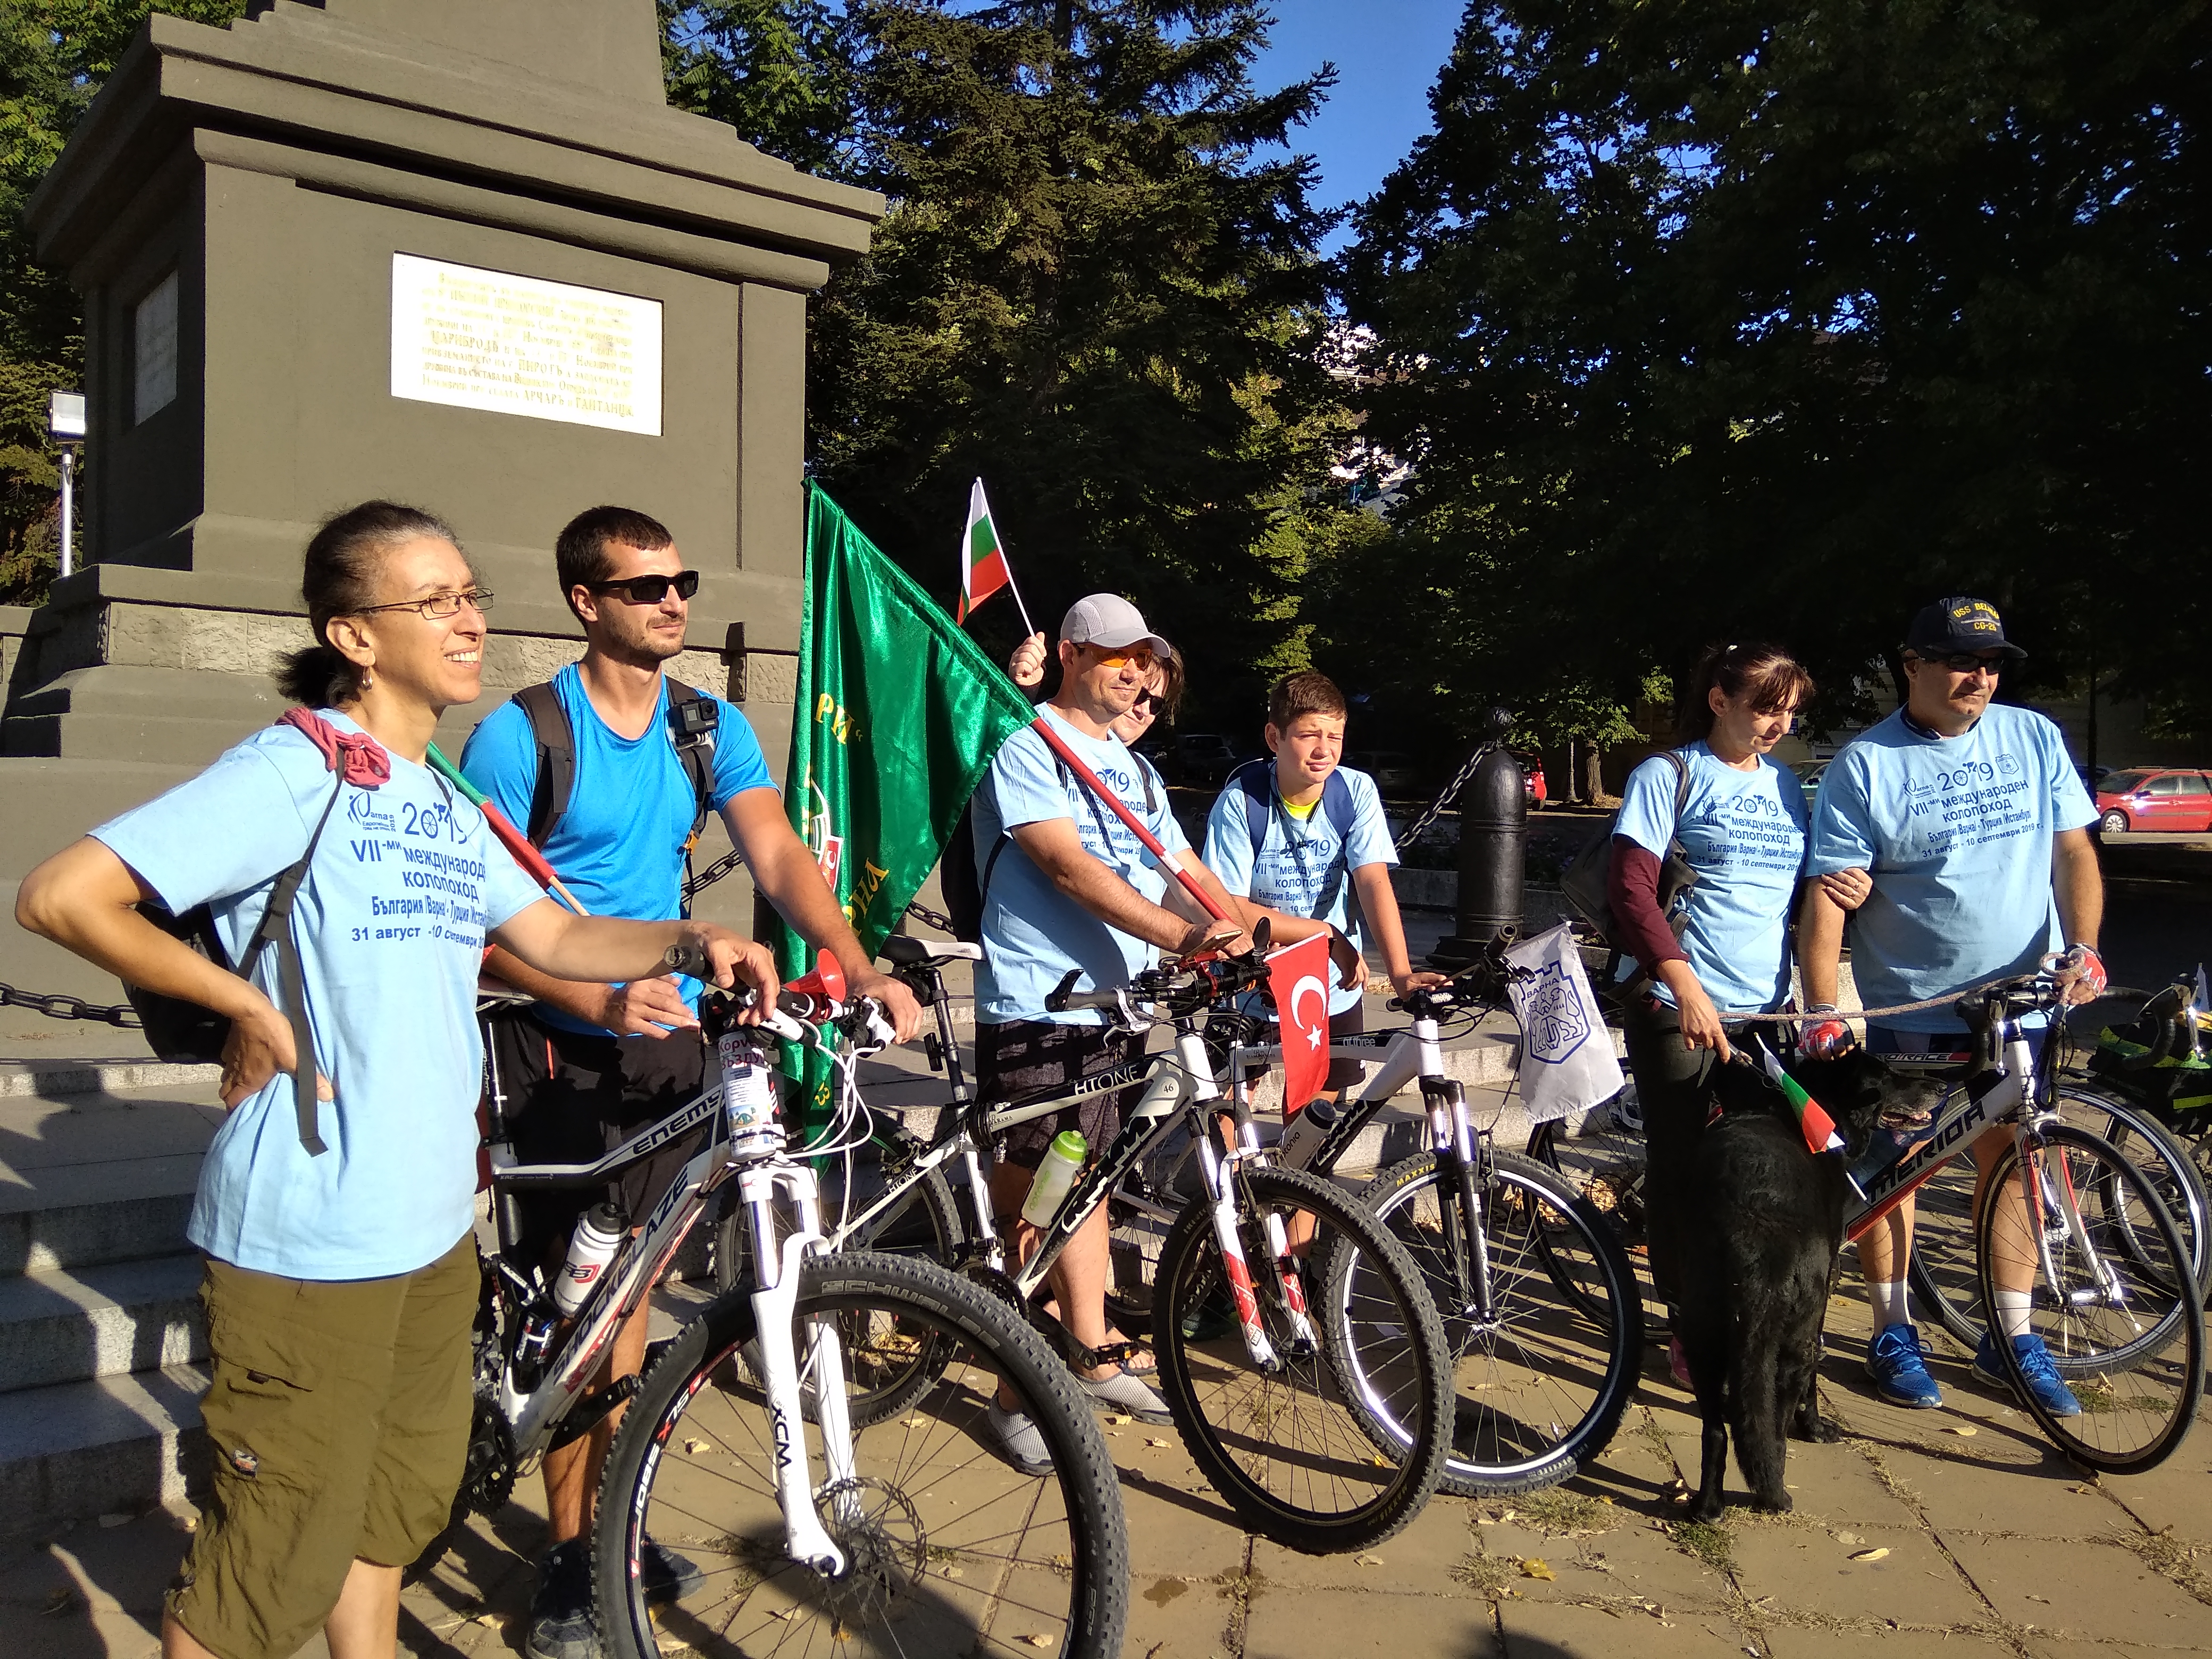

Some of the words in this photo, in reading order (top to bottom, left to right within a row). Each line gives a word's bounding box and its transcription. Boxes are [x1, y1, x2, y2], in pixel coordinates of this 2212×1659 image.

[1954, 606, 1972, 617] USS
[1732, 795, 1778, 816] 2019
[1941, 780, 2029, 808] международен
[1942, 799, 2013, 823] колопоход
[1729, 828, 1790, 846] колопоход
[1922, 849, 1932, 858] 31
[1935, 842, 1958, 856] август
[1977, 829, 2021, 844] септември
[2021, 825, 2035, 834] 2019
[1928, 827, 1957, 843] България
[1980, 817, 2002, 833] Турция
[1707, 841, 1737, 855] България
[1762, 845, 1778, 858] Турция
[402, 847, 486, 882] международ
[1697, 855, 1705, 864] 31
[1750, 861, 1786, 871] септември
[402, 870, 480, 904] колопоход
[1275, 873, 1332, 887] колопоход
[1258, 889, 1283, 902] България
[372, 896, 423, 919] България
[450, 900, 468, 925] Турция
[351, 927, 369, 941] 31
[375, 927, 421, 941] август
[1527, 977, 1560, 999] ВАРНА
[1163, 1083, 1174, 1093] 46
[1870, 1100, 1985, 1204] MERIDA
[1396, 1163, 1435, 1187] MAXXIS
[553, 1165, 689, 1382] SHOCKBLAZE
[772, 1403, 792, 1469] XCM
